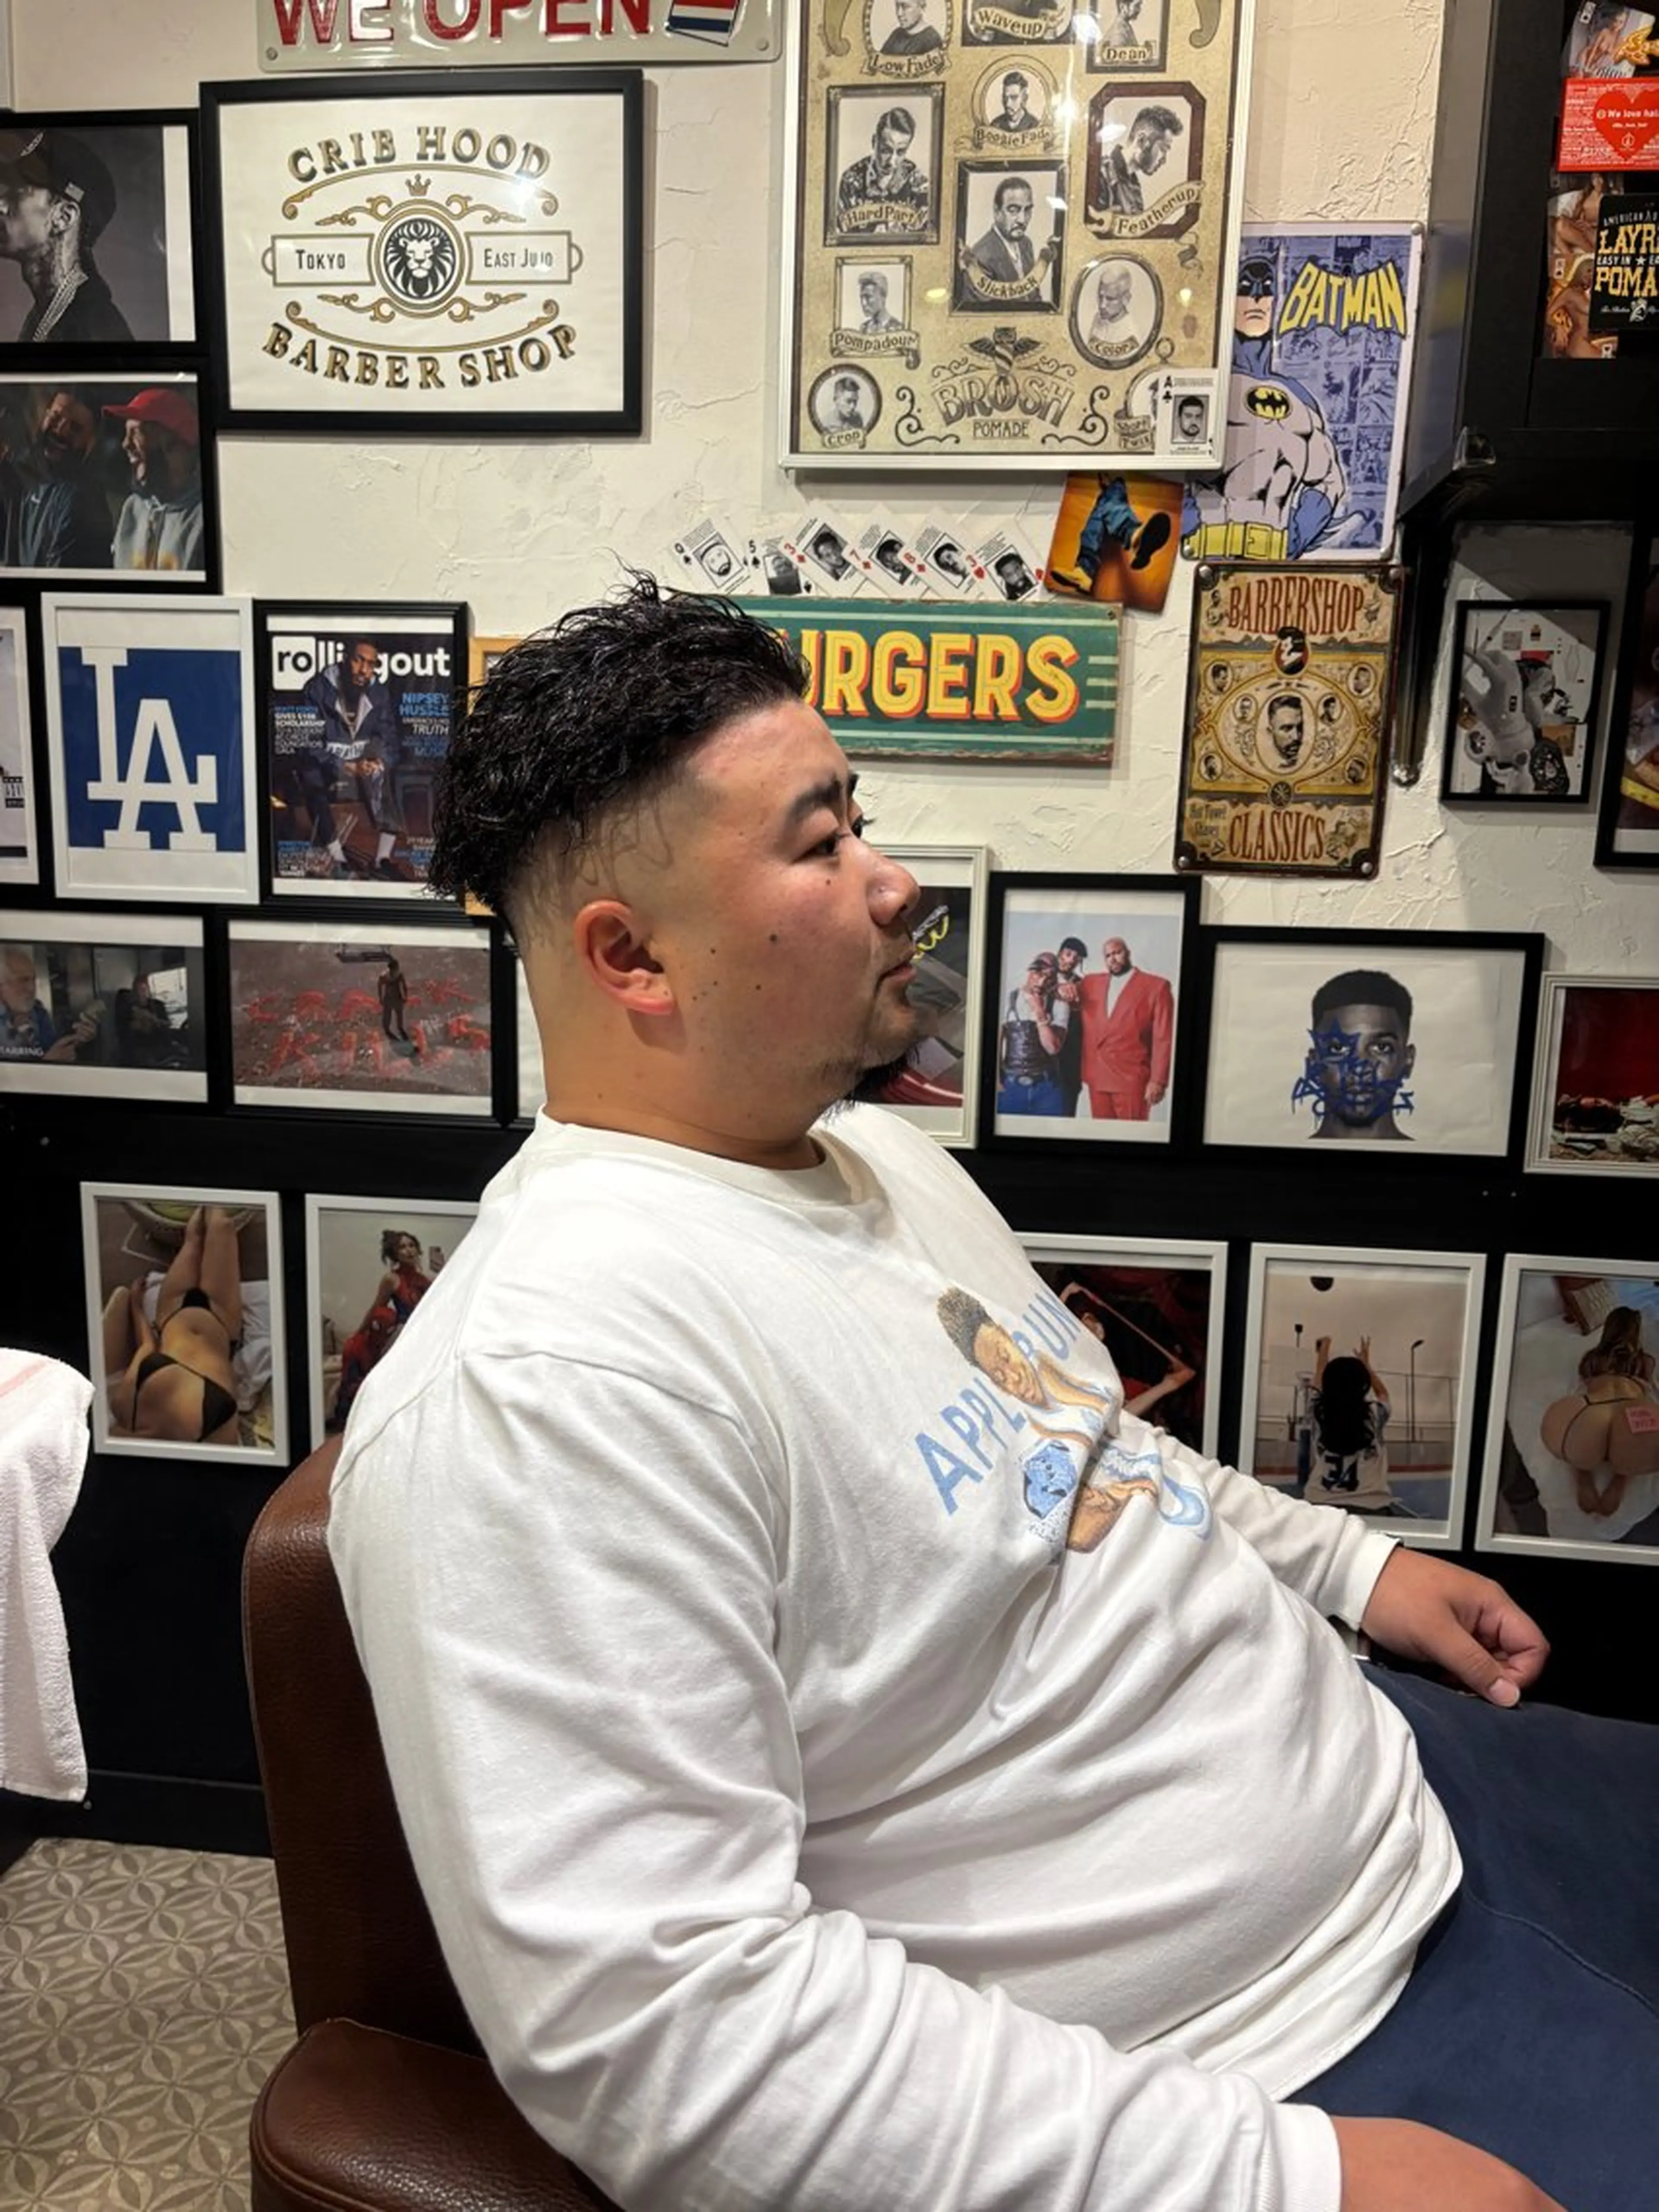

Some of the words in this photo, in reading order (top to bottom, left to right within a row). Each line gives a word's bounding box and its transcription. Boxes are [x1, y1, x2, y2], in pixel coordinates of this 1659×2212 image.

[274, 0, 394, 44] WE
[1107, 48, 1146, 59] Dean
[287, 129, 397, 182] CRIB
[416, 125, 551, 180] HOOD
[1597, 255, 1618, 265] EASY
[1621, 256, 1630, 265] IN
[1598, 223, 1659, 254] LAYR
[1278, 261, 1407, 339] BATMAN
[262, 322, 445, 389] BARBER
[459, 323, 578, 387] SHOP
[931, 373, 1075, 426] BROSH
[973, 421, 1029, 437] POMADE
[1227, 575, 1365, 635] BARBERSHOP
[278, 640, 451, 684] rolligout
[402, 692, 450, 704] NIPSEY
[81, 647, 218, 851] LA
[413, 724, 449, 735] TRUTH
[1228, 810, 1326, 862] CLASSICS
